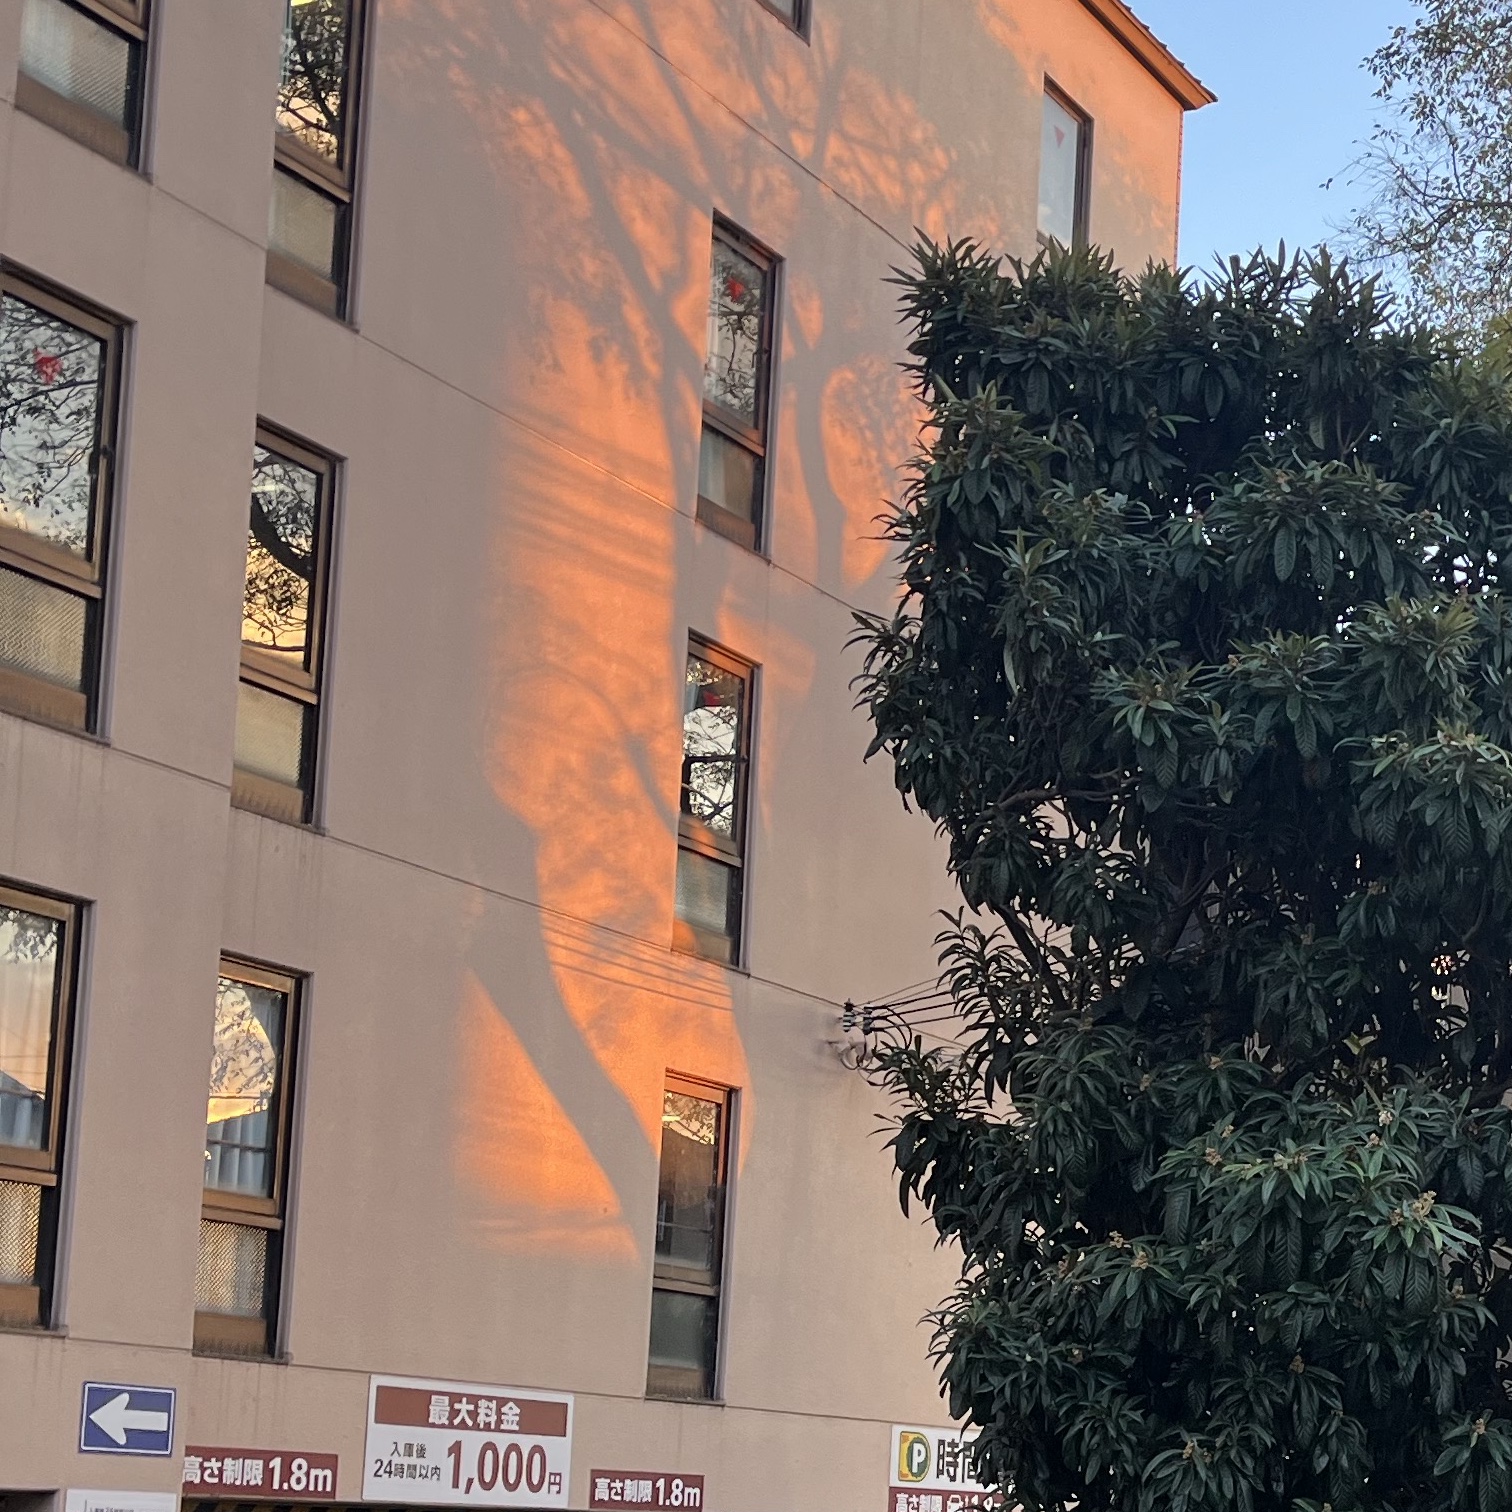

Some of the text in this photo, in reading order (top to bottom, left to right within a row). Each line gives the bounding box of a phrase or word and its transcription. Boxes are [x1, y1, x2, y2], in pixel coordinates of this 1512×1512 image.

[428, 1395, 521, 1431] 最大料金
[390, 1441, 427, 1459] 入庫後
[184, 1456, 333, 1492] 高さ制限 1.8m
[373, 1458, 441, 1481] 24時間以内
[447, 1440, 562, 1495] 1,000円
[594, 1478, 701, 1507] 高さ制限 1.8m
